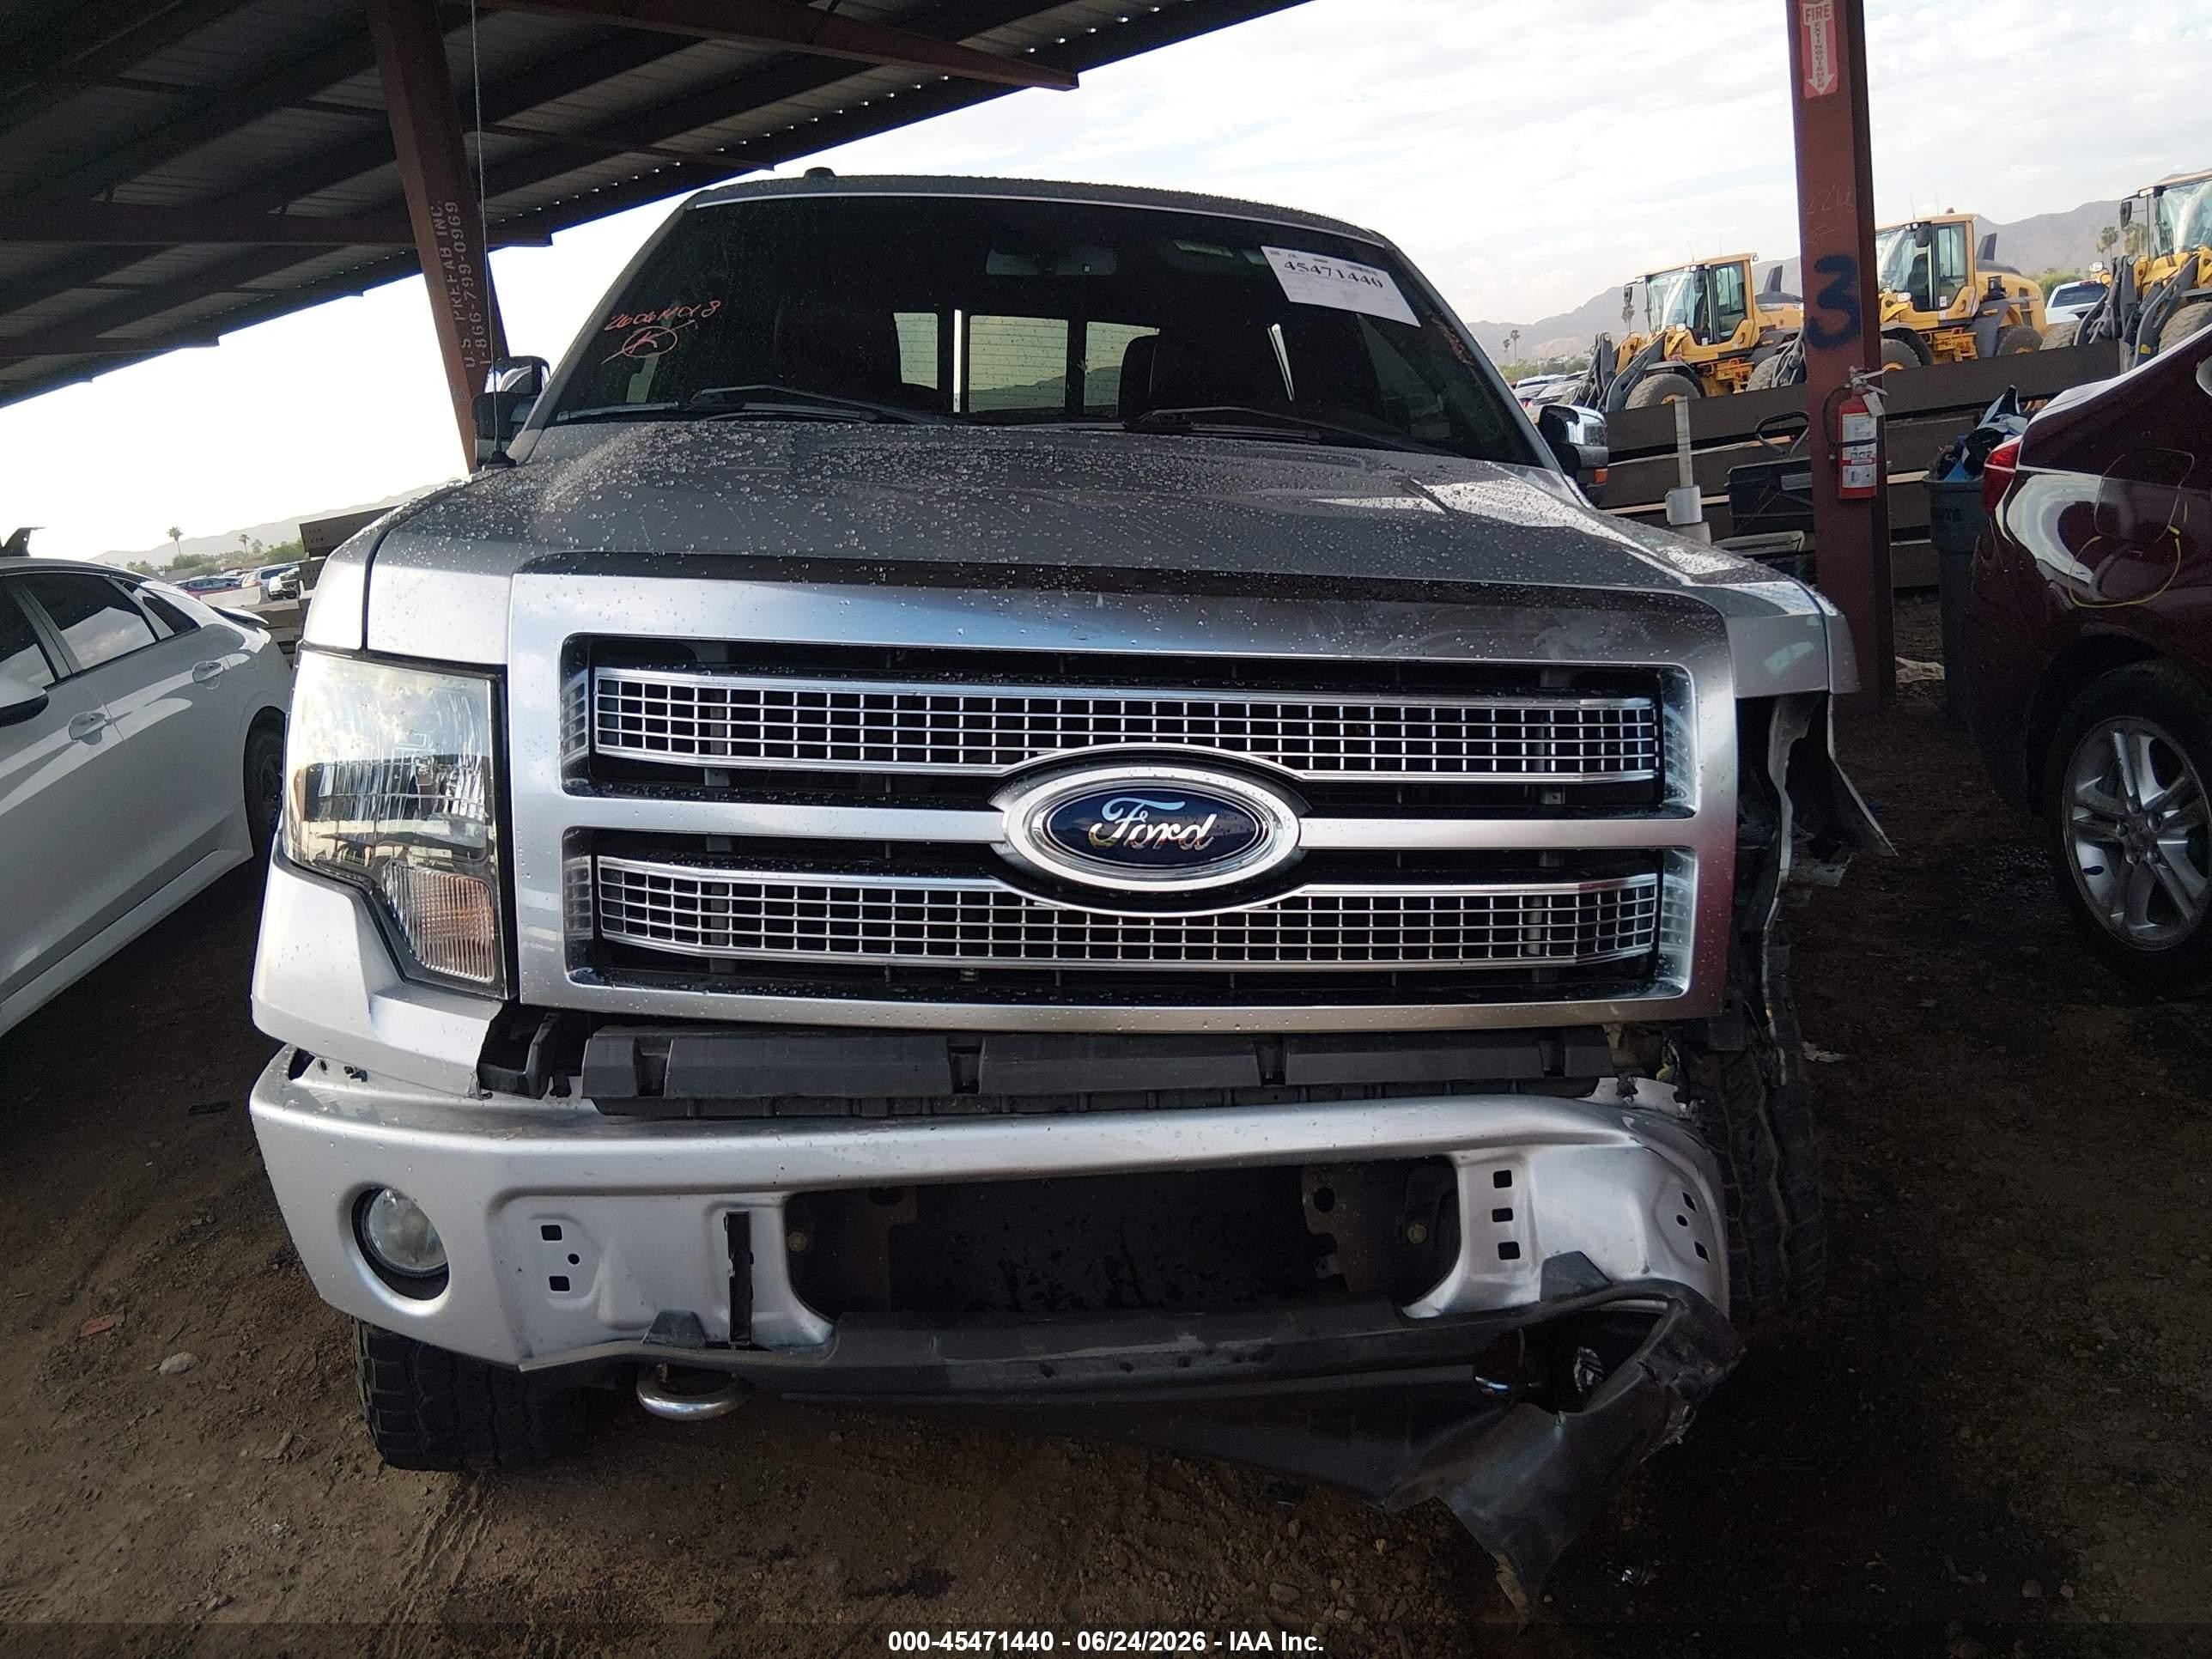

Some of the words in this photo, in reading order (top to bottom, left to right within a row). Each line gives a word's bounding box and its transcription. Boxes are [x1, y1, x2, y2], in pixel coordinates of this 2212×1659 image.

[1805, 4, 1832, 23] FIRE
[429, 199, 449, 237] INC.
[439, 246, 467, 321] PREFAB
[445, 201, 491, 366] 1-866-799-0969
[1284, 261, 1383, 289] 45471440
[1806, 254, 1862, 349] 3
[1088, 797, 1218, 850] Ford
